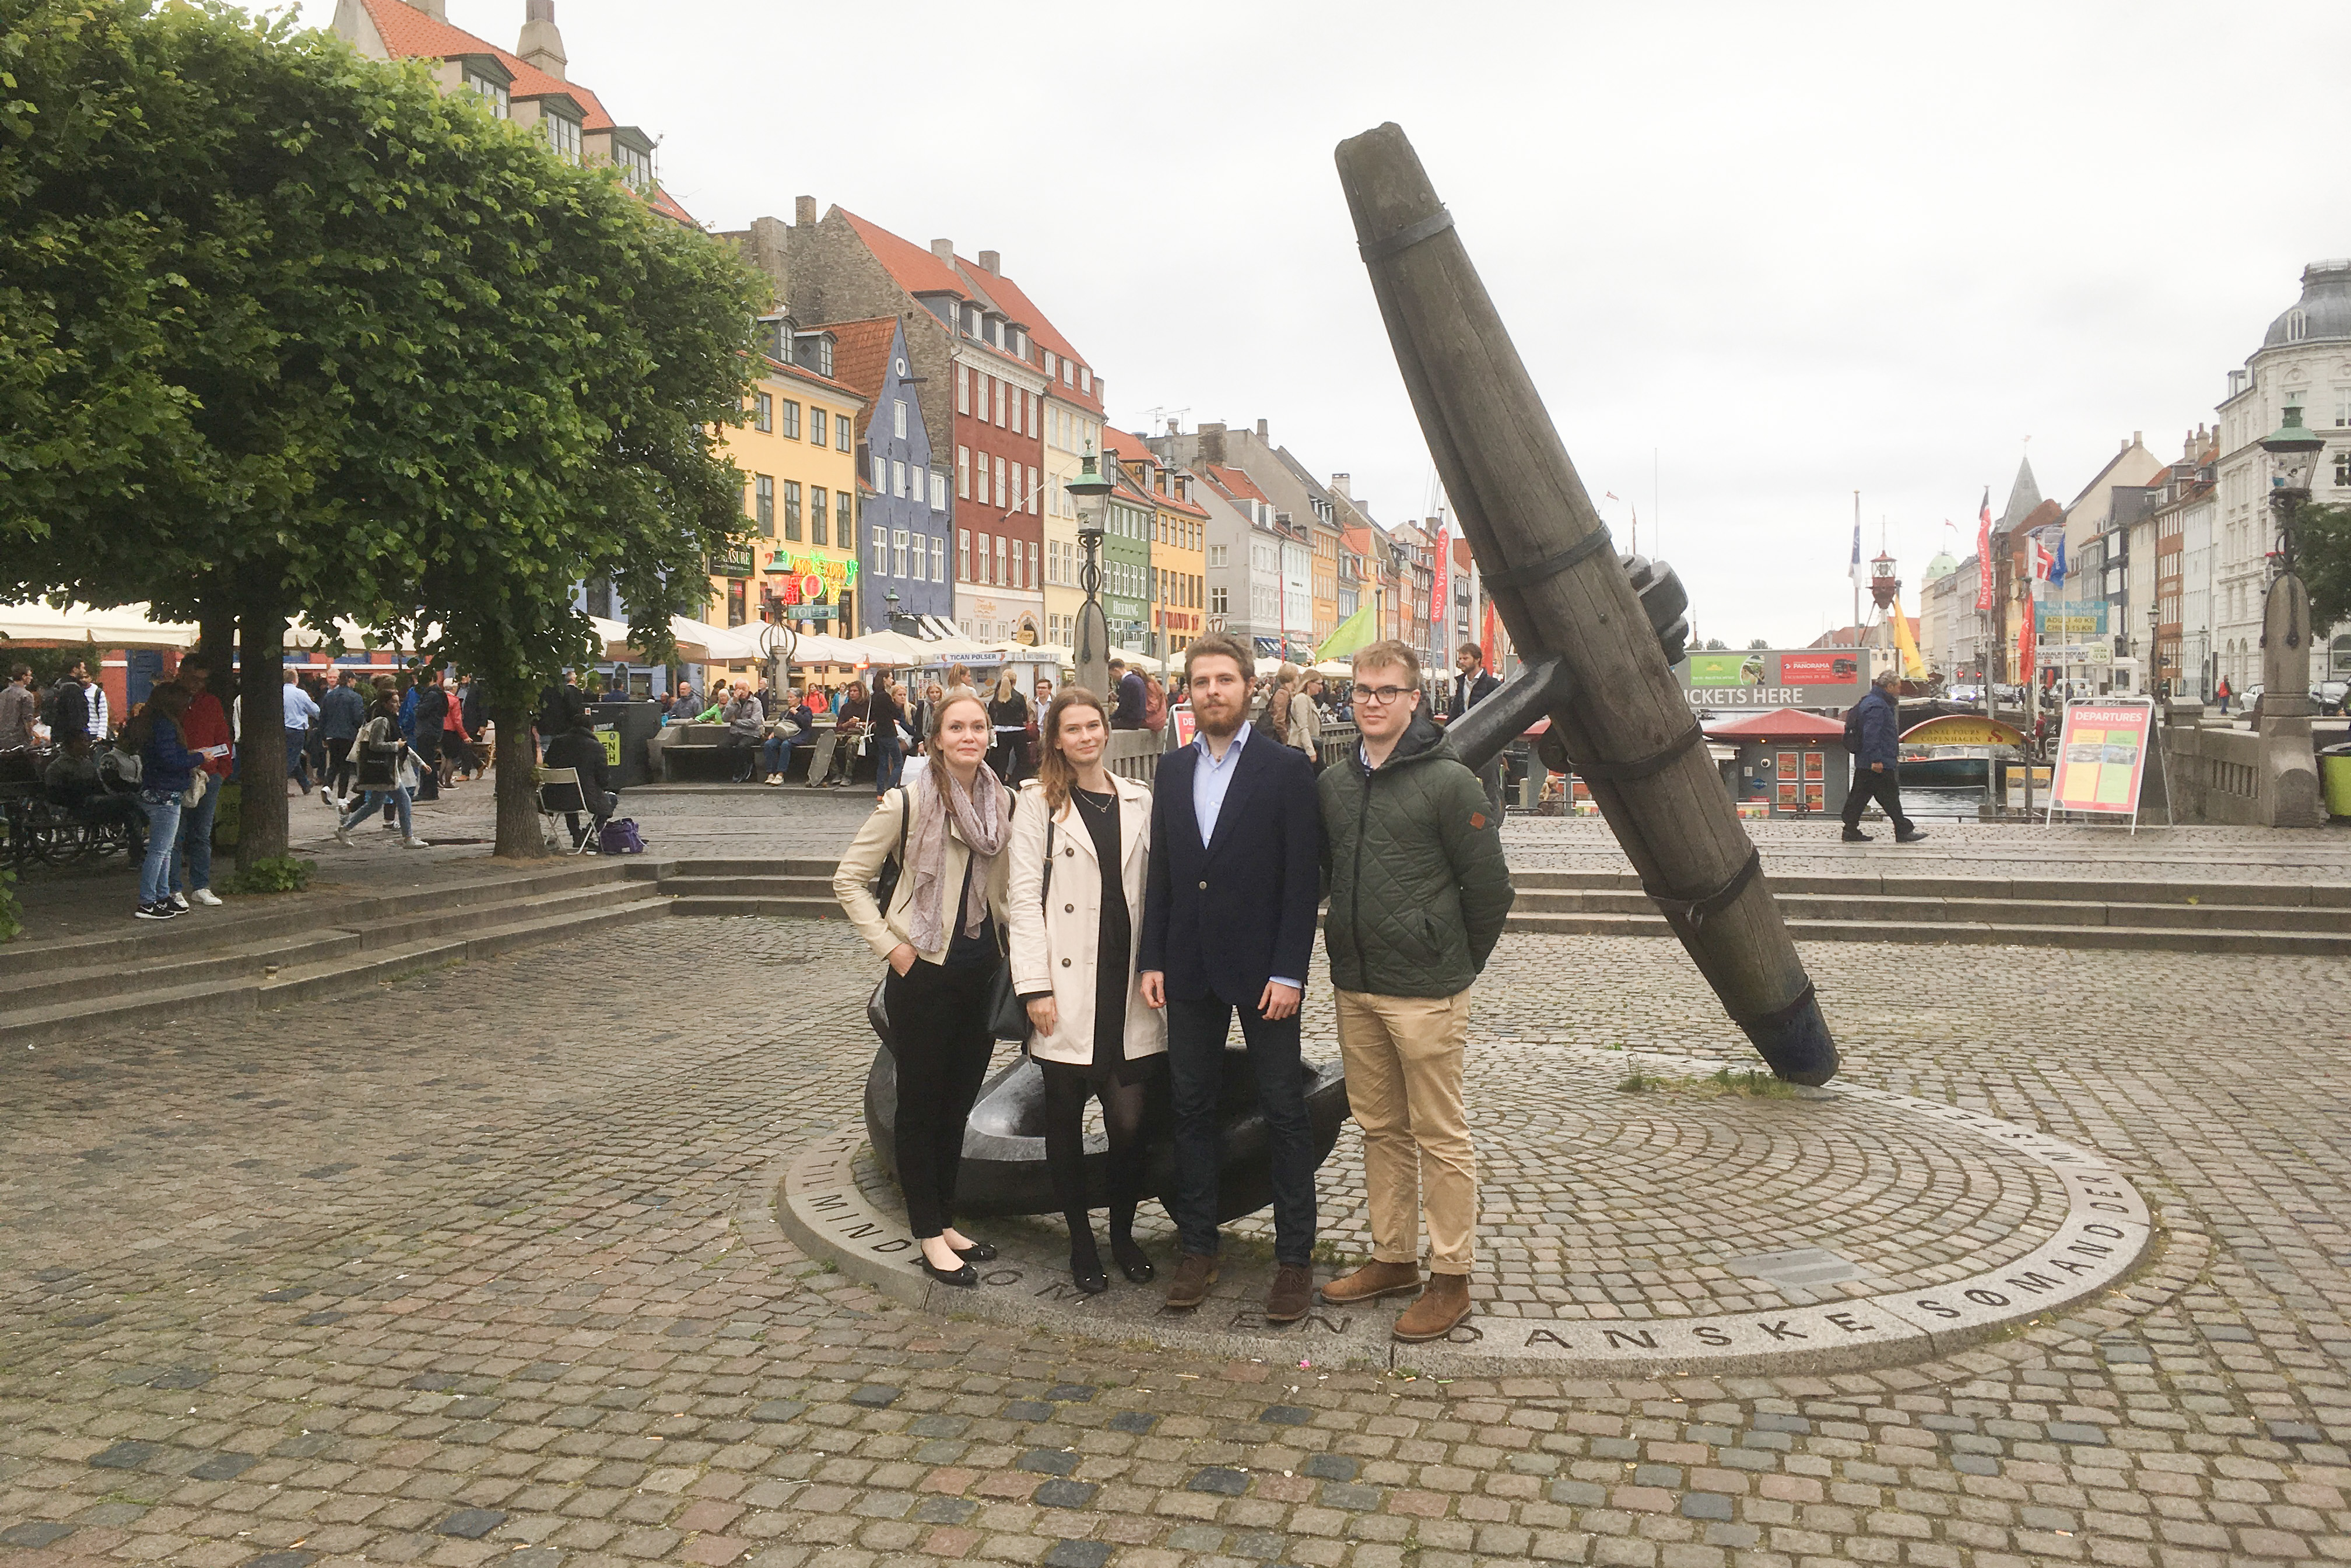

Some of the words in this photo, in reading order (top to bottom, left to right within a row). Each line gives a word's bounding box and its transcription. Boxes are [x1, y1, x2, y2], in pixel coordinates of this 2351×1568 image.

[1113, 600, 1139, 616] HEERING
[1208, 618, 1223, 633] 17
[1683, 688, 1747, 705] ICKETS
[1753, 687, 1803, 704] HERE
[2075, 711, 2143, 722] DEPARTURES
[808, 1193, 924, 1268] MIND
